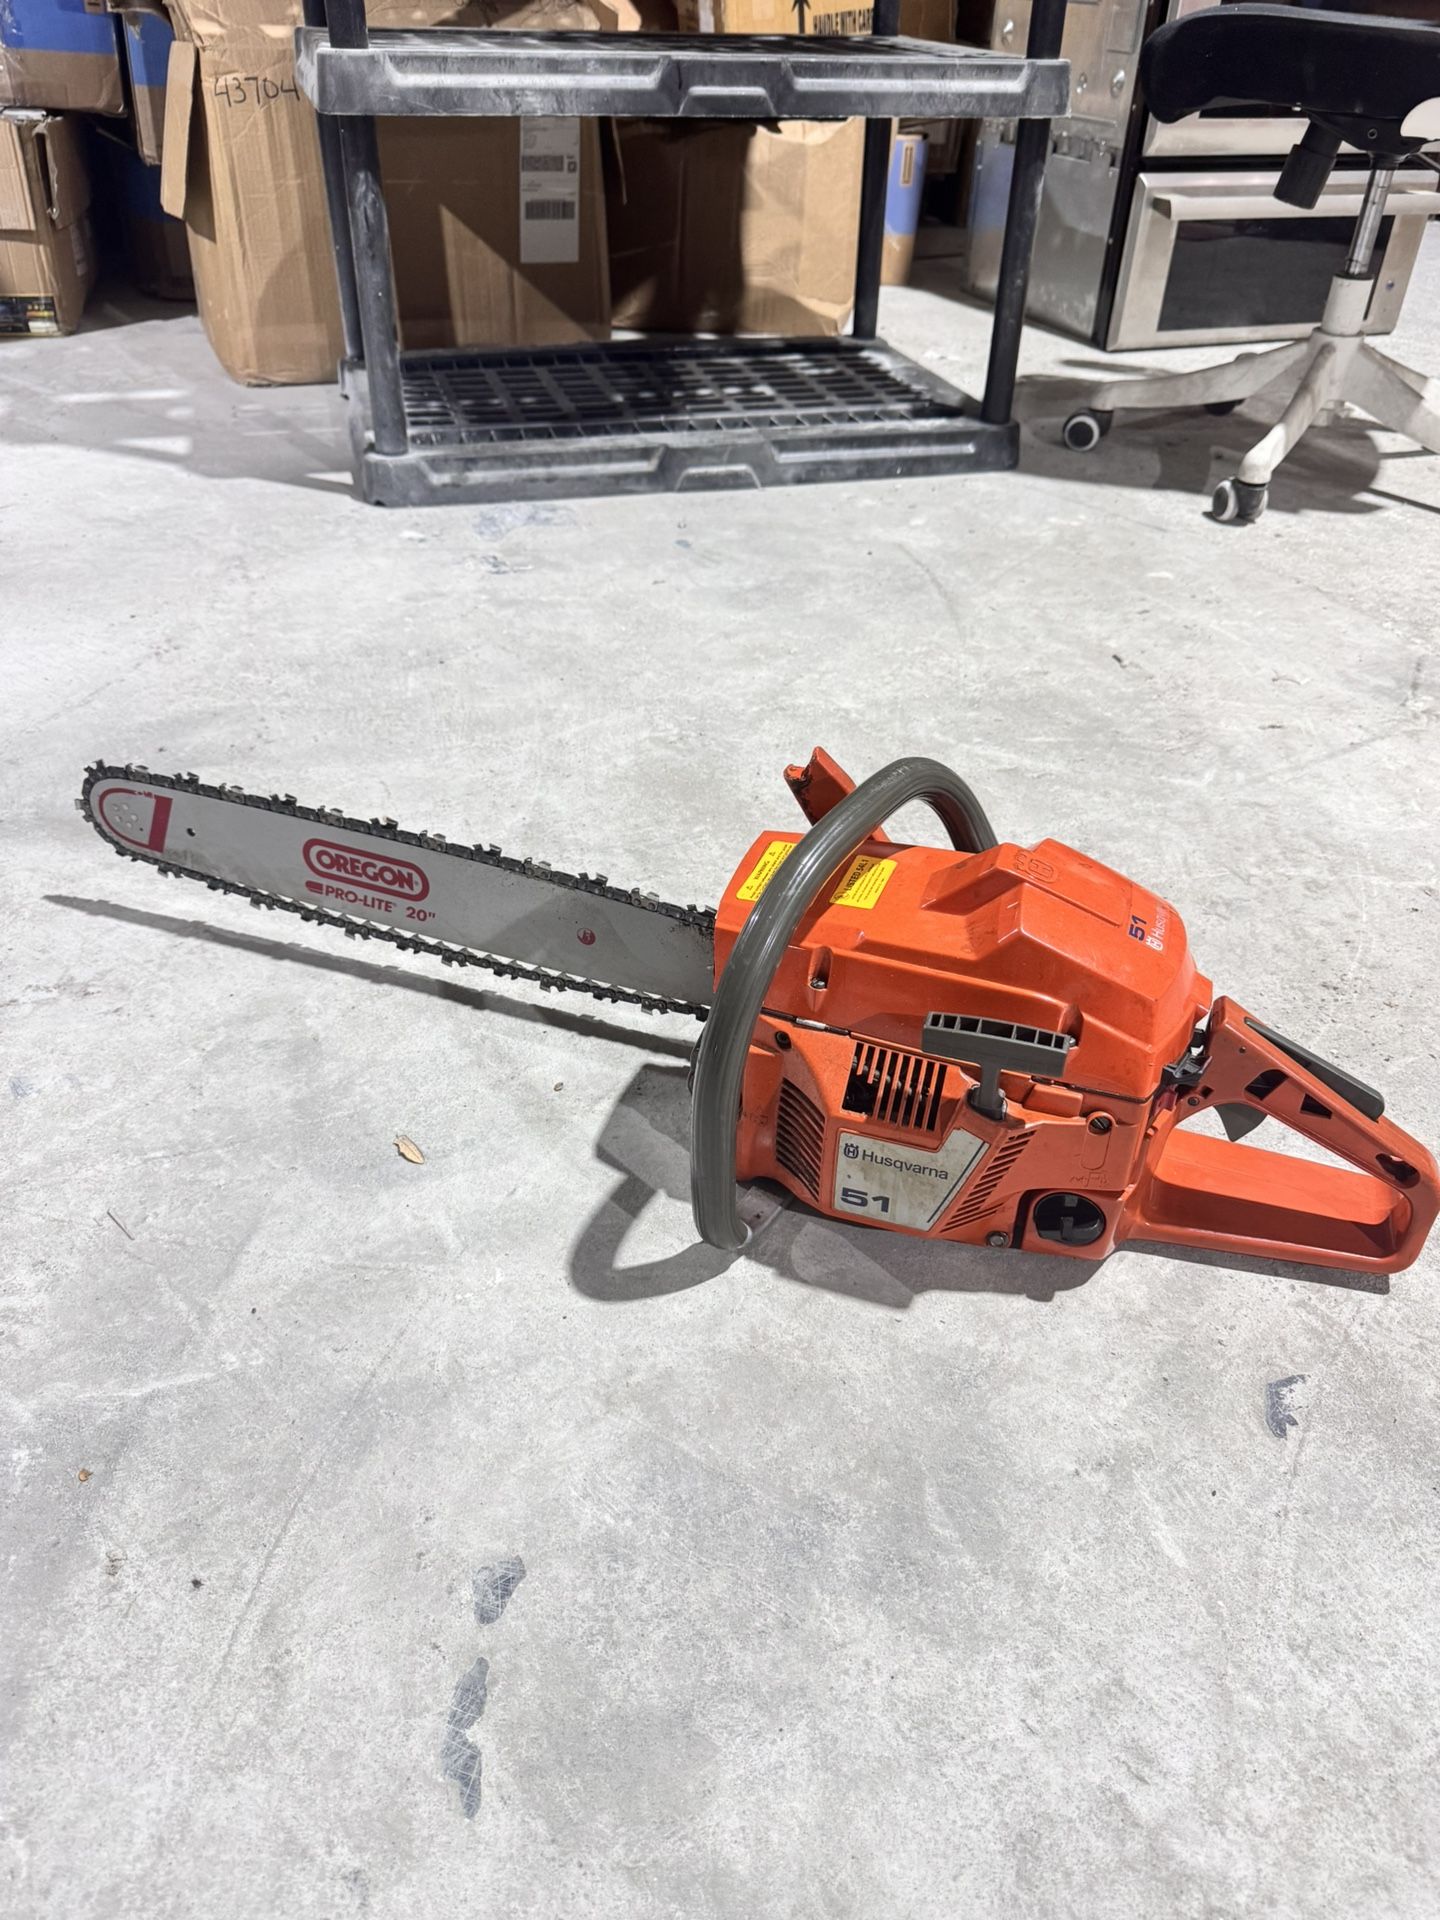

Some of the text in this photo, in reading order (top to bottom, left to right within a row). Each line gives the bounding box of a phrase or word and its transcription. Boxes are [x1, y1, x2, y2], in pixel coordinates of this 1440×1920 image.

[214, 75, 300, 107] 43704
[316, 849, 415, 891] OREGON
[325, 885, 394, 912] PRO-LITE
[1129, 915, 1147, 941] 51
[862, 1149, 949, 1180] Husqvarna
[840, 1187, 890, 1213] 51
